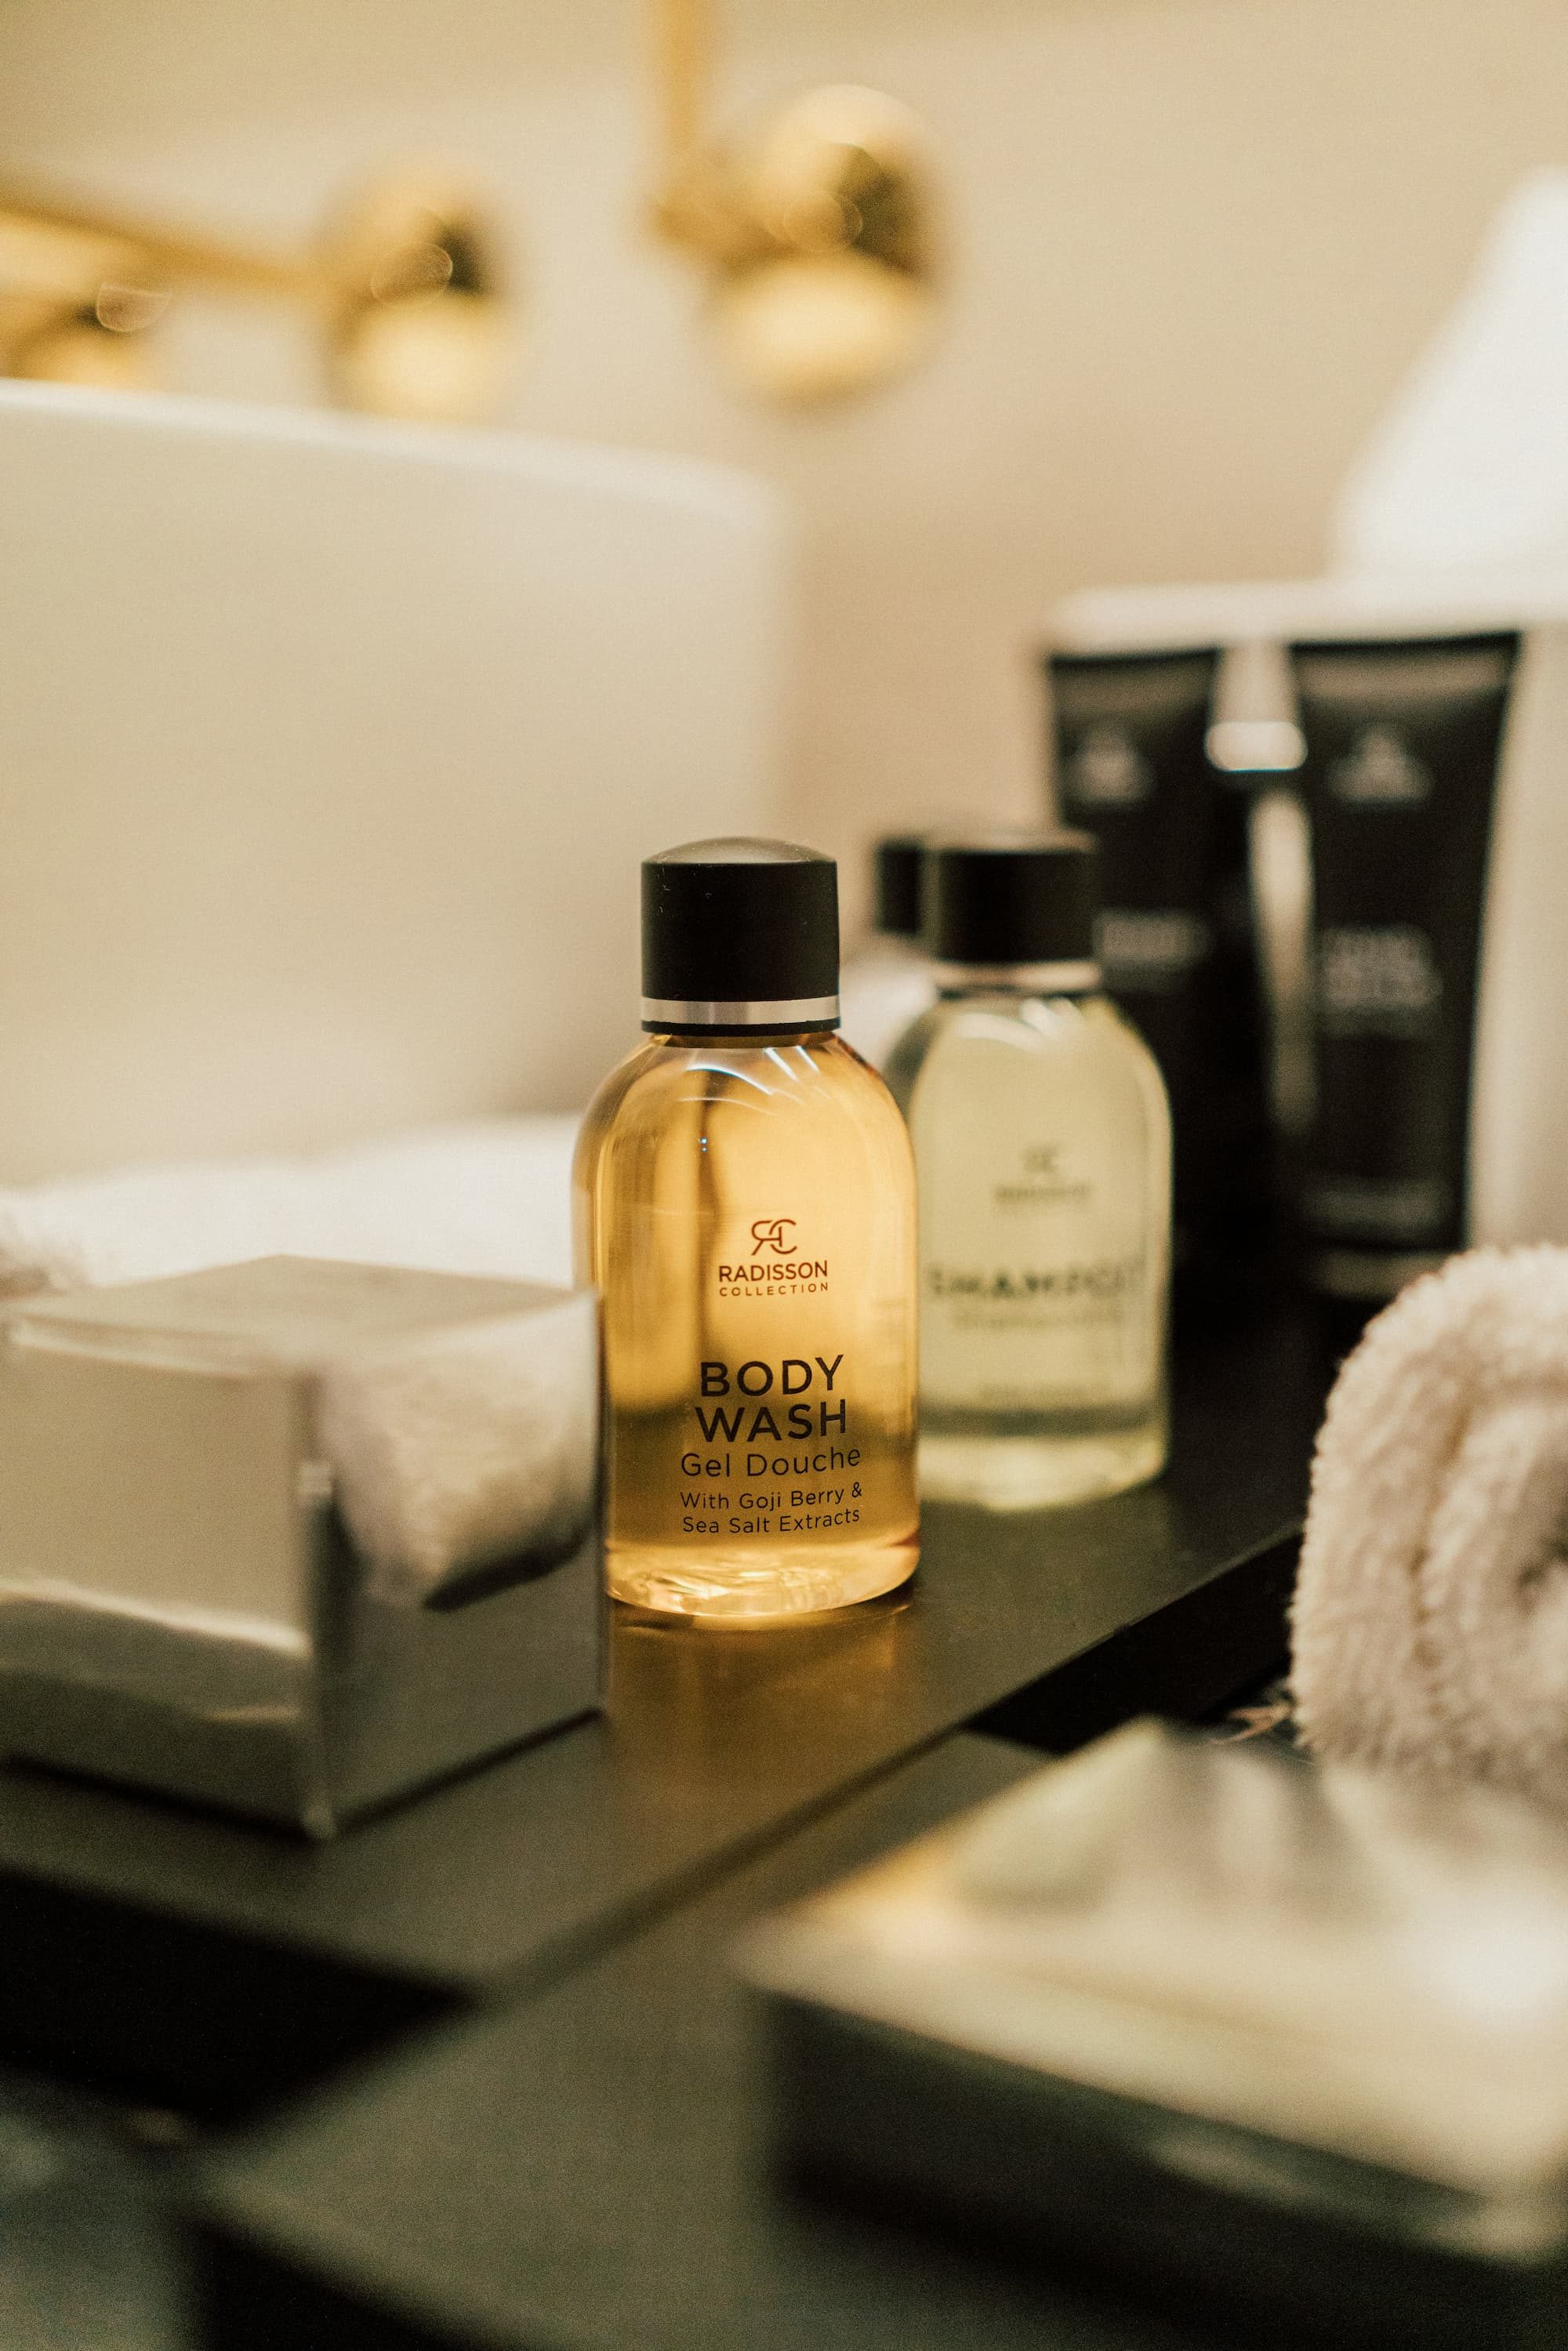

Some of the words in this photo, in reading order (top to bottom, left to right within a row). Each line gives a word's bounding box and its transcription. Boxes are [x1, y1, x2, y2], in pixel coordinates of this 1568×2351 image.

[719, 1260, 828, 1282] RADISSON
[719, 1282, 829, 1297] COLLECTION
[700, 1354, 844, 1397] BODY
[695, 1399, 846, 1442] WASH
[681, 1453, 730, 1477] Gel
[747, 1447, 861, 1477] Douche
[681, 1492, 729, 1509] With
[739, 1492, 781, 1511] Goji
[791, 1486, 844, 1507] Berry
[851, 1482, 862, 1498] &
[683, 1517, 719, 1533] Sea
[729, 1515, 770, 1533] Salt
[780, 1507, 860, 1532] Extracts
